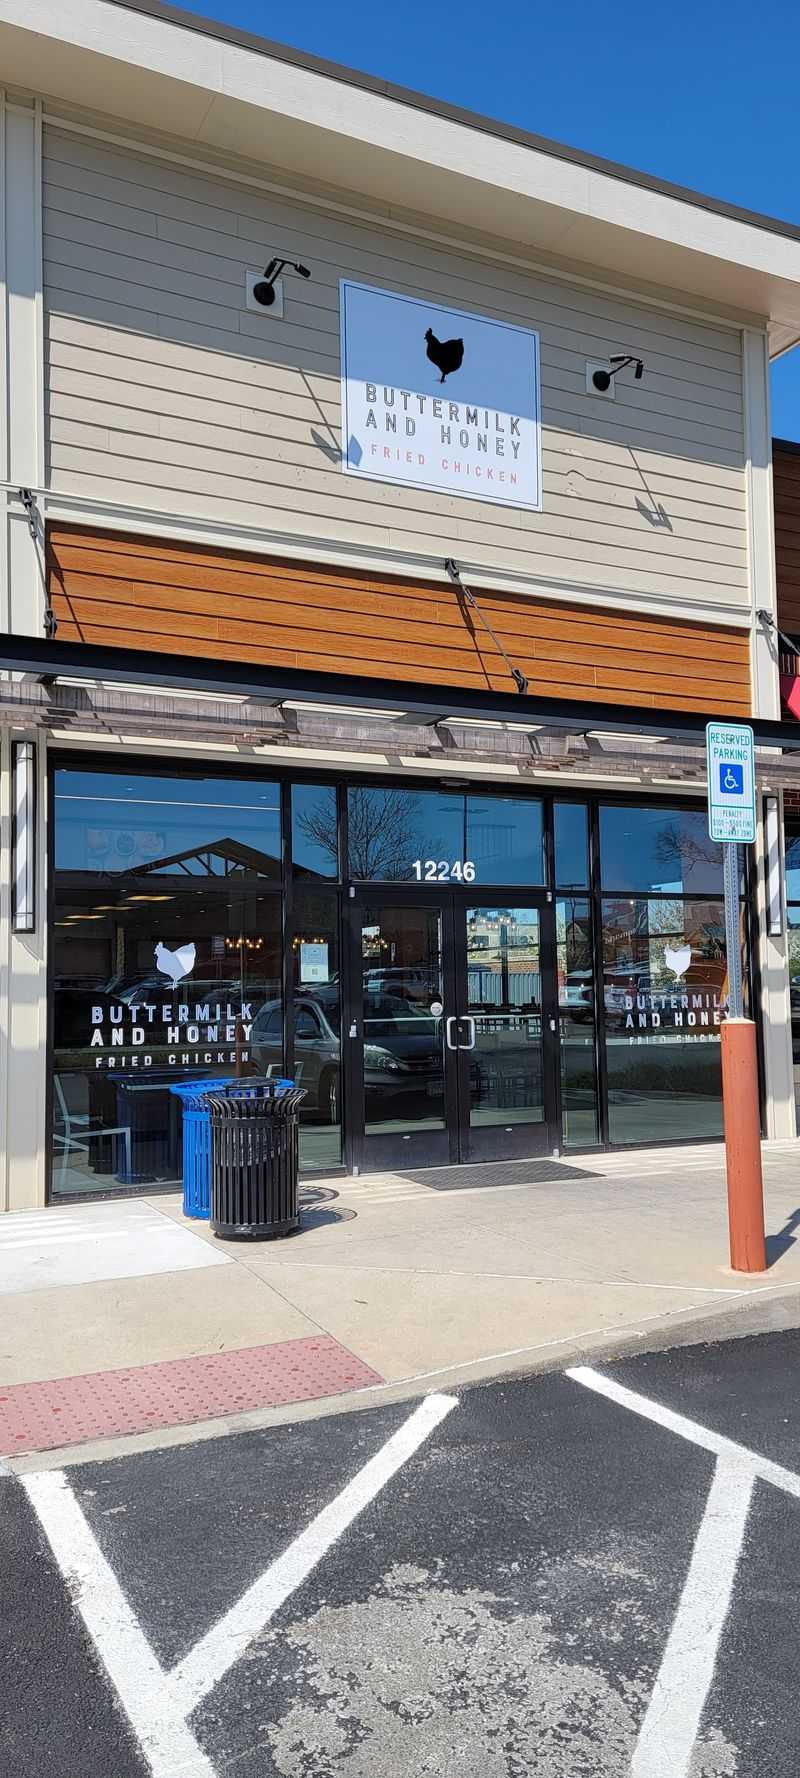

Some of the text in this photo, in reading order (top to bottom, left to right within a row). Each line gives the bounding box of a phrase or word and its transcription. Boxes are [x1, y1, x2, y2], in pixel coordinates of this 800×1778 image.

[366, 383, 521, 436] BUTTERMILK
[365, 409, 521, 459] AND HONEY
[371, 444, 518, 484] FRIED CHICKEN
[710, 732, 750, 746] RESERVED
[713, 747, 748, 761] PARKING
[411, 859, 476, 882] 12246
[91, 1003, 253, 1024] BUTTERMILK
[625, 1012, 661, 1028] AND
[90, 1025, 253, 1047] AND HONEY
[676, 1033, 721, 1043] CHICKE
[95, 1052, 249, 1068] FRIED CHICKEN
